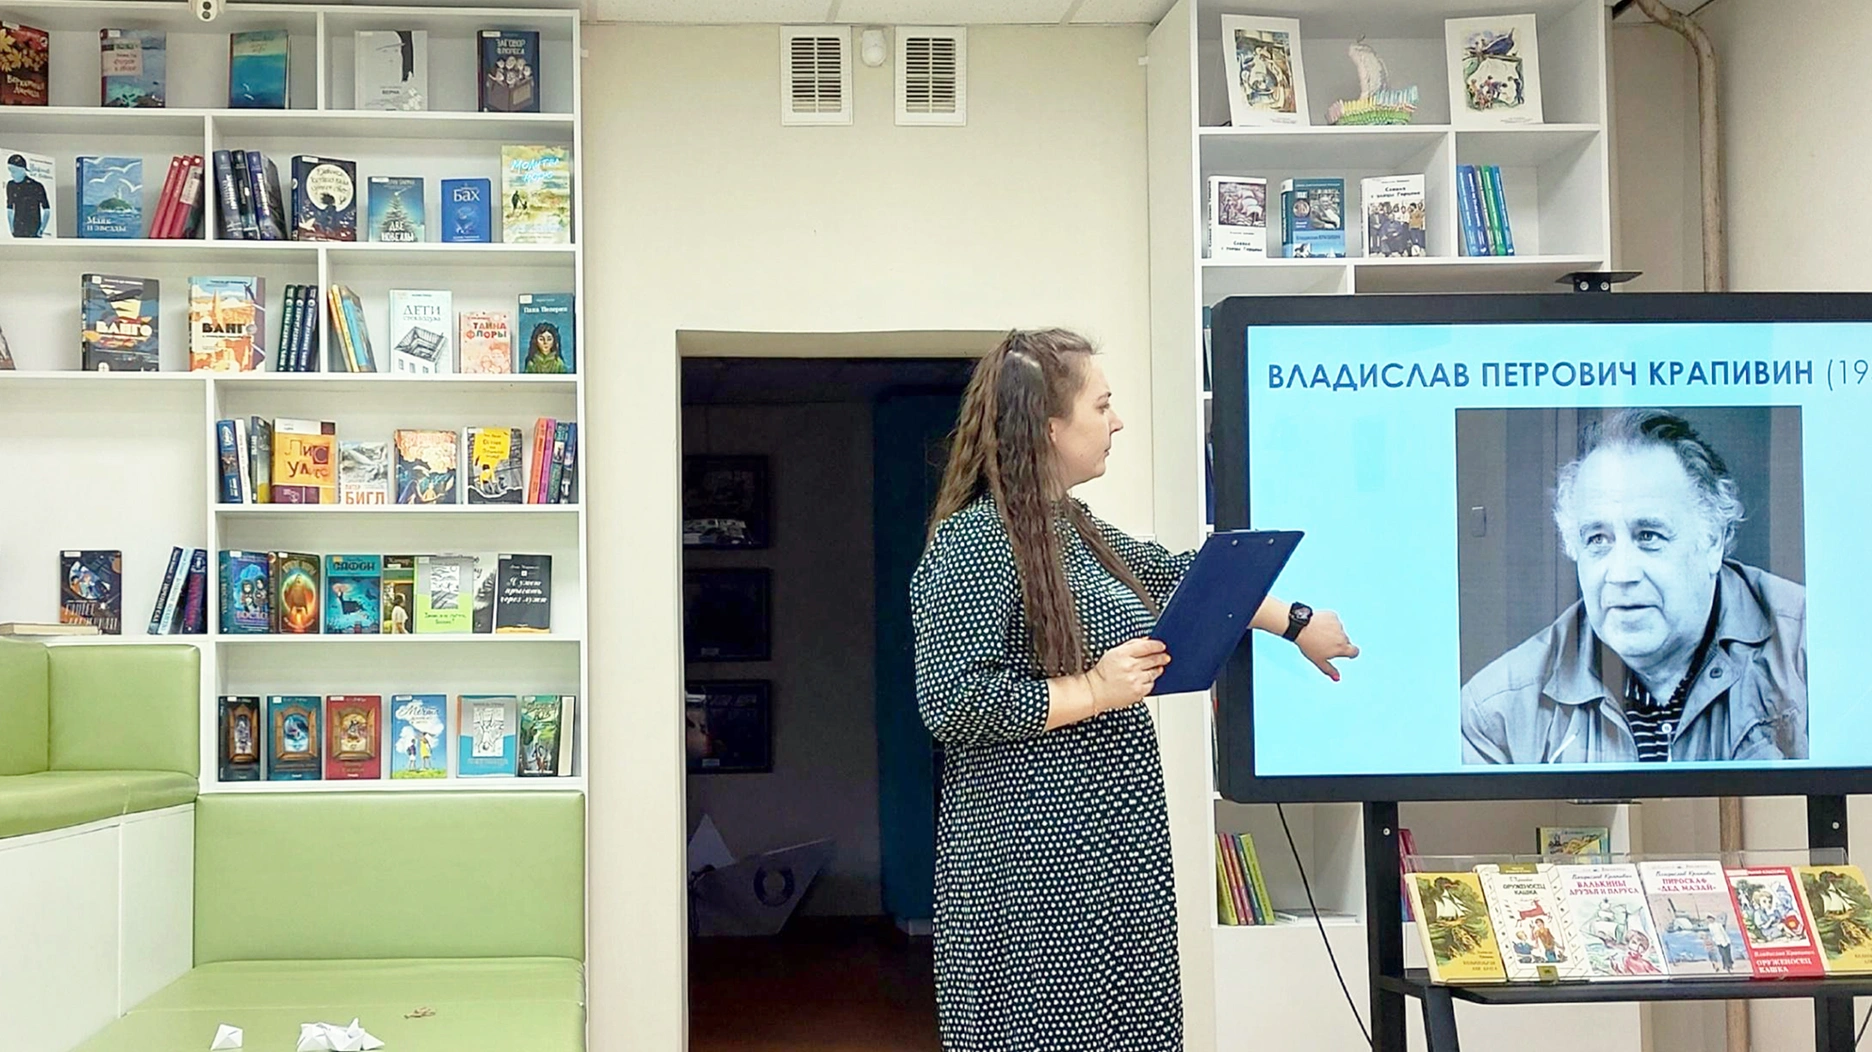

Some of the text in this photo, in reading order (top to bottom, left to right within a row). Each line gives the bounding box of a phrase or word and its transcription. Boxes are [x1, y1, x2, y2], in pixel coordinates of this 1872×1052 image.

[453, 188, 480, 202] Бах
[403, 305, 441, 315] ДЕТИ
[1268, 358, 1872, 392] ВЛАДИСЛАВ ПЕТРОВИЧ КРАПИВИН (19
[345, 491, 385, 505] БИГЛ
[1576, 880, 1627, 888] ВАЛЬКИНЫ
[1756, 957, 1813, 967] ОРУЖЕНОСЕЦ
[1758, 966, 1790, 974] КАШКА
